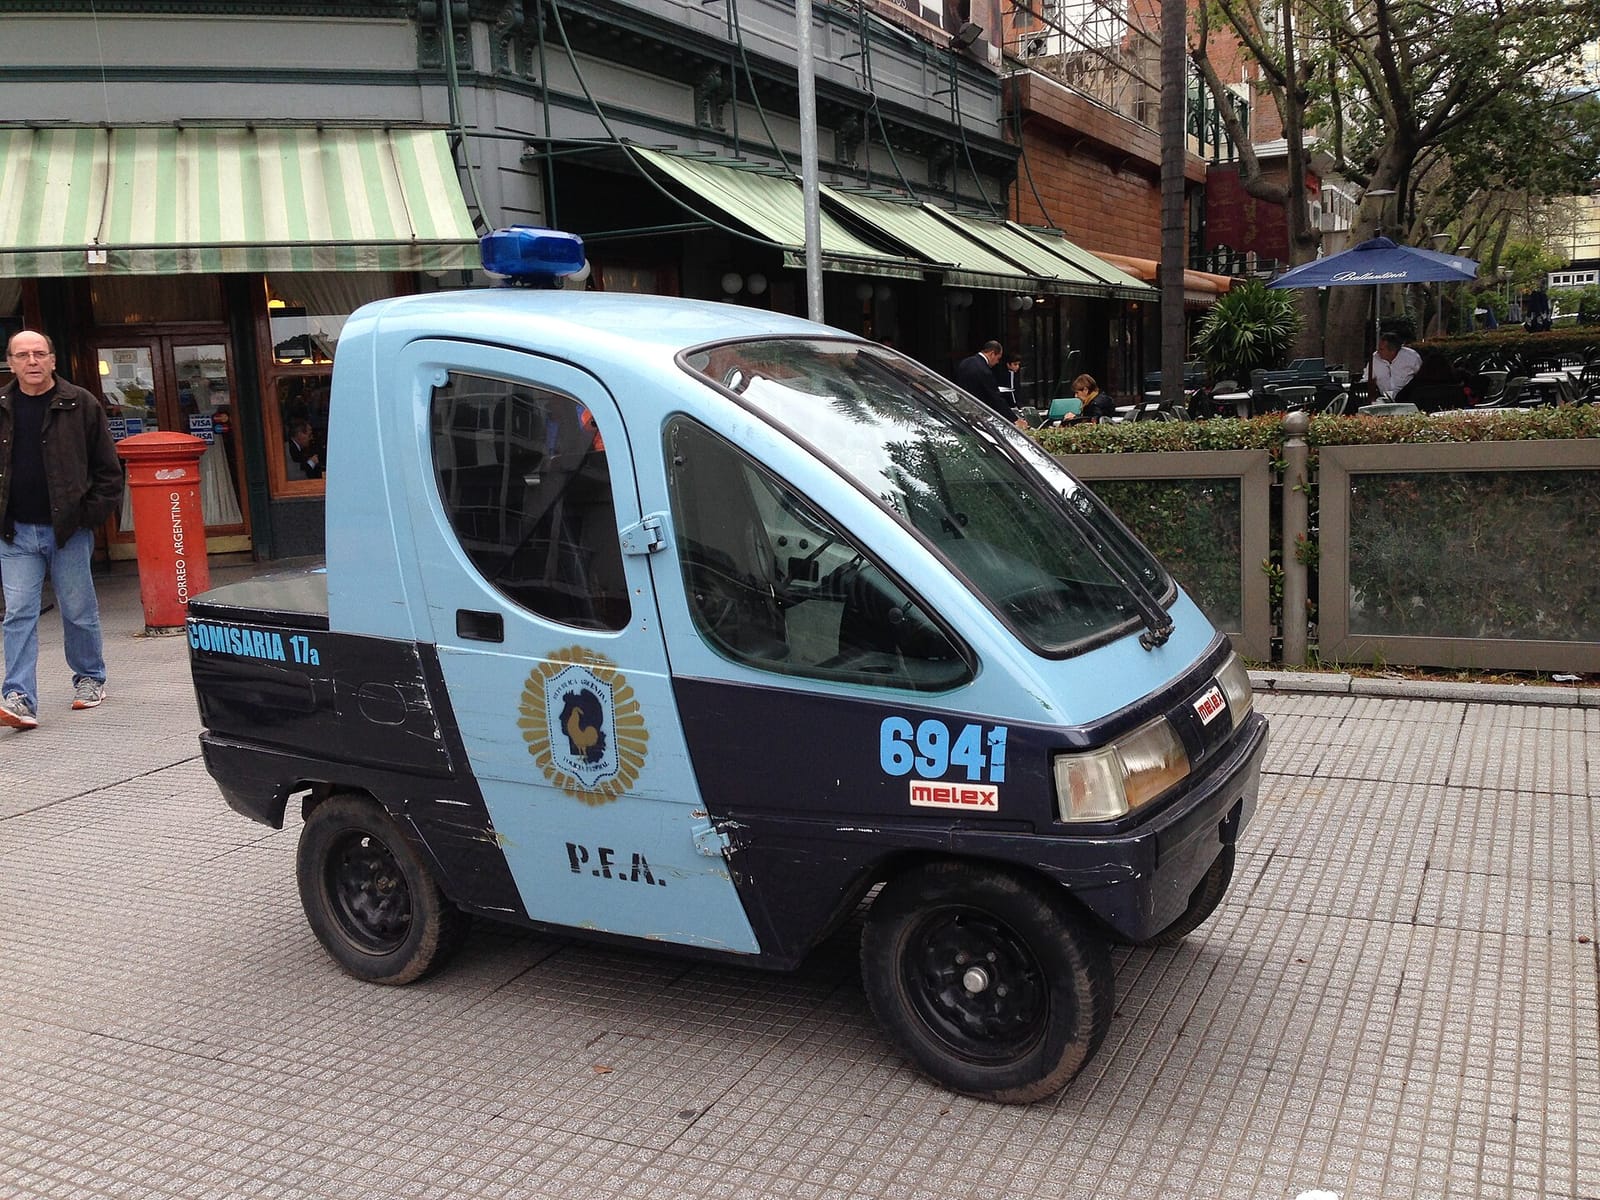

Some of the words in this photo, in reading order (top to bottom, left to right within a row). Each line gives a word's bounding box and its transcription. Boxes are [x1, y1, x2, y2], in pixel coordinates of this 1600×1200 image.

[192, 419, 211, 427] VISA
[170, 492, 185, 555] ARGENTINO
[175, 559, 188, 604] CORREO
[188, 623, 286, 662] COMISARIA
[289, 635, 320, 666] 17a
[1197, 691, 1224, 721] melex
[880, 716, 1008, 783] 6941
[912, 786, 995, 806] melex
[565, 842, 667, 887] P.F.A.
